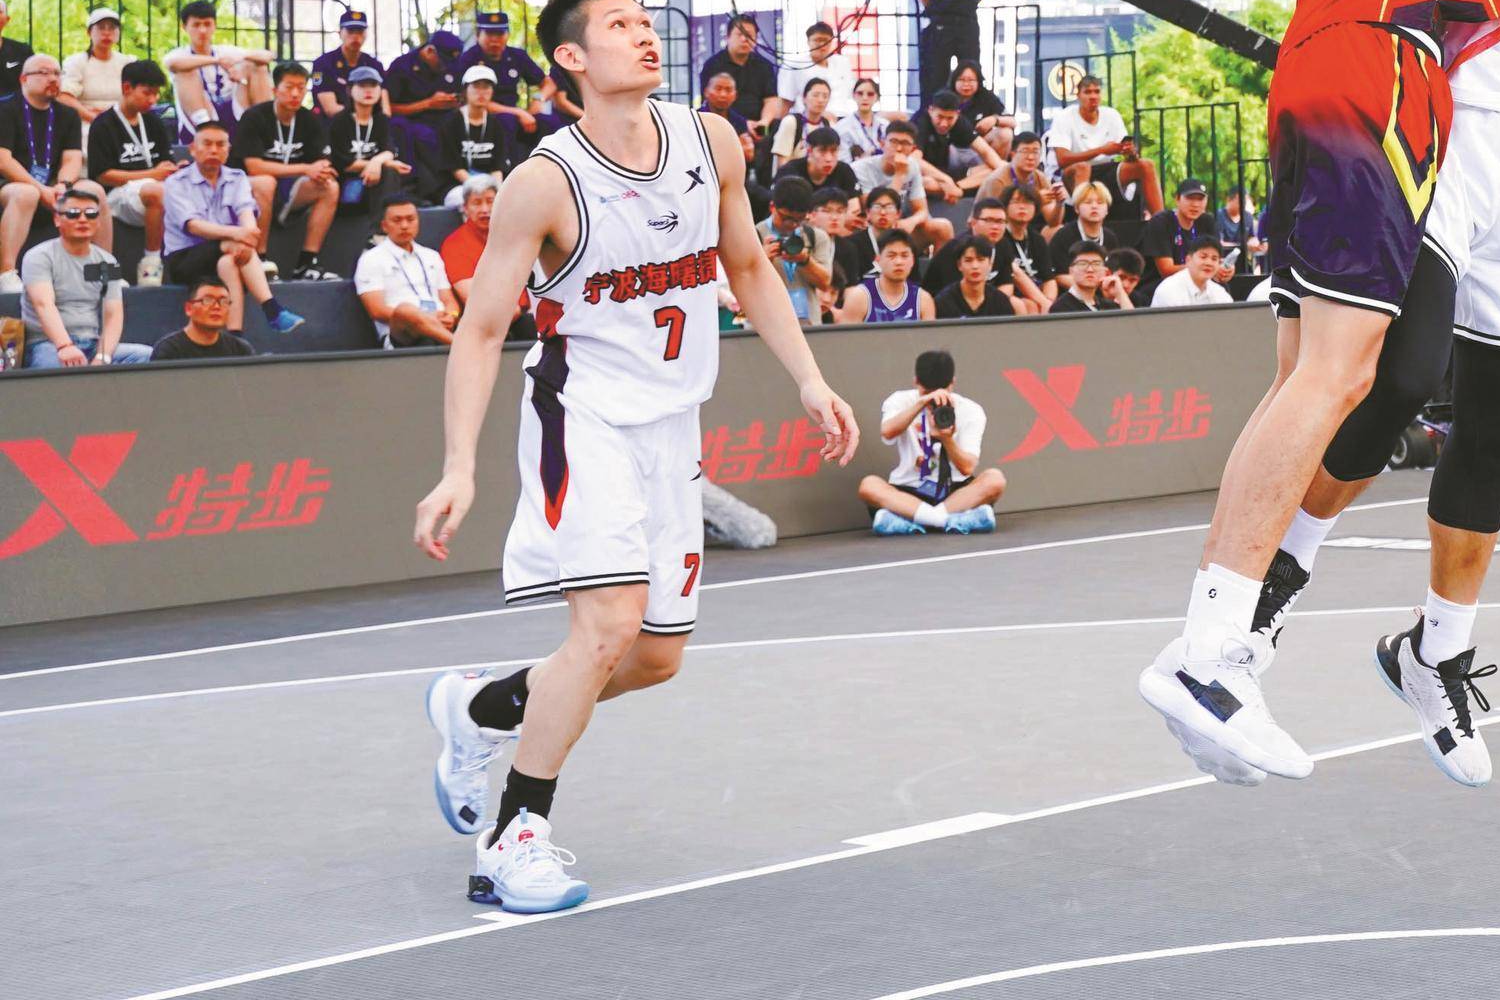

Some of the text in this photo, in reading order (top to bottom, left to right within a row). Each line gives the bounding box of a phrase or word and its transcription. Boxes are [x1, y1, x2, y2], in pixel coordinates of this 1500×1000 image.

[653, 305, 687, 362] 7
[1103, 386, 1213, 448] 特步
[701, 418, 826, 485] 特步
[146, 457, 333, 542] 特步
[680, 552, 701, 597] 7
